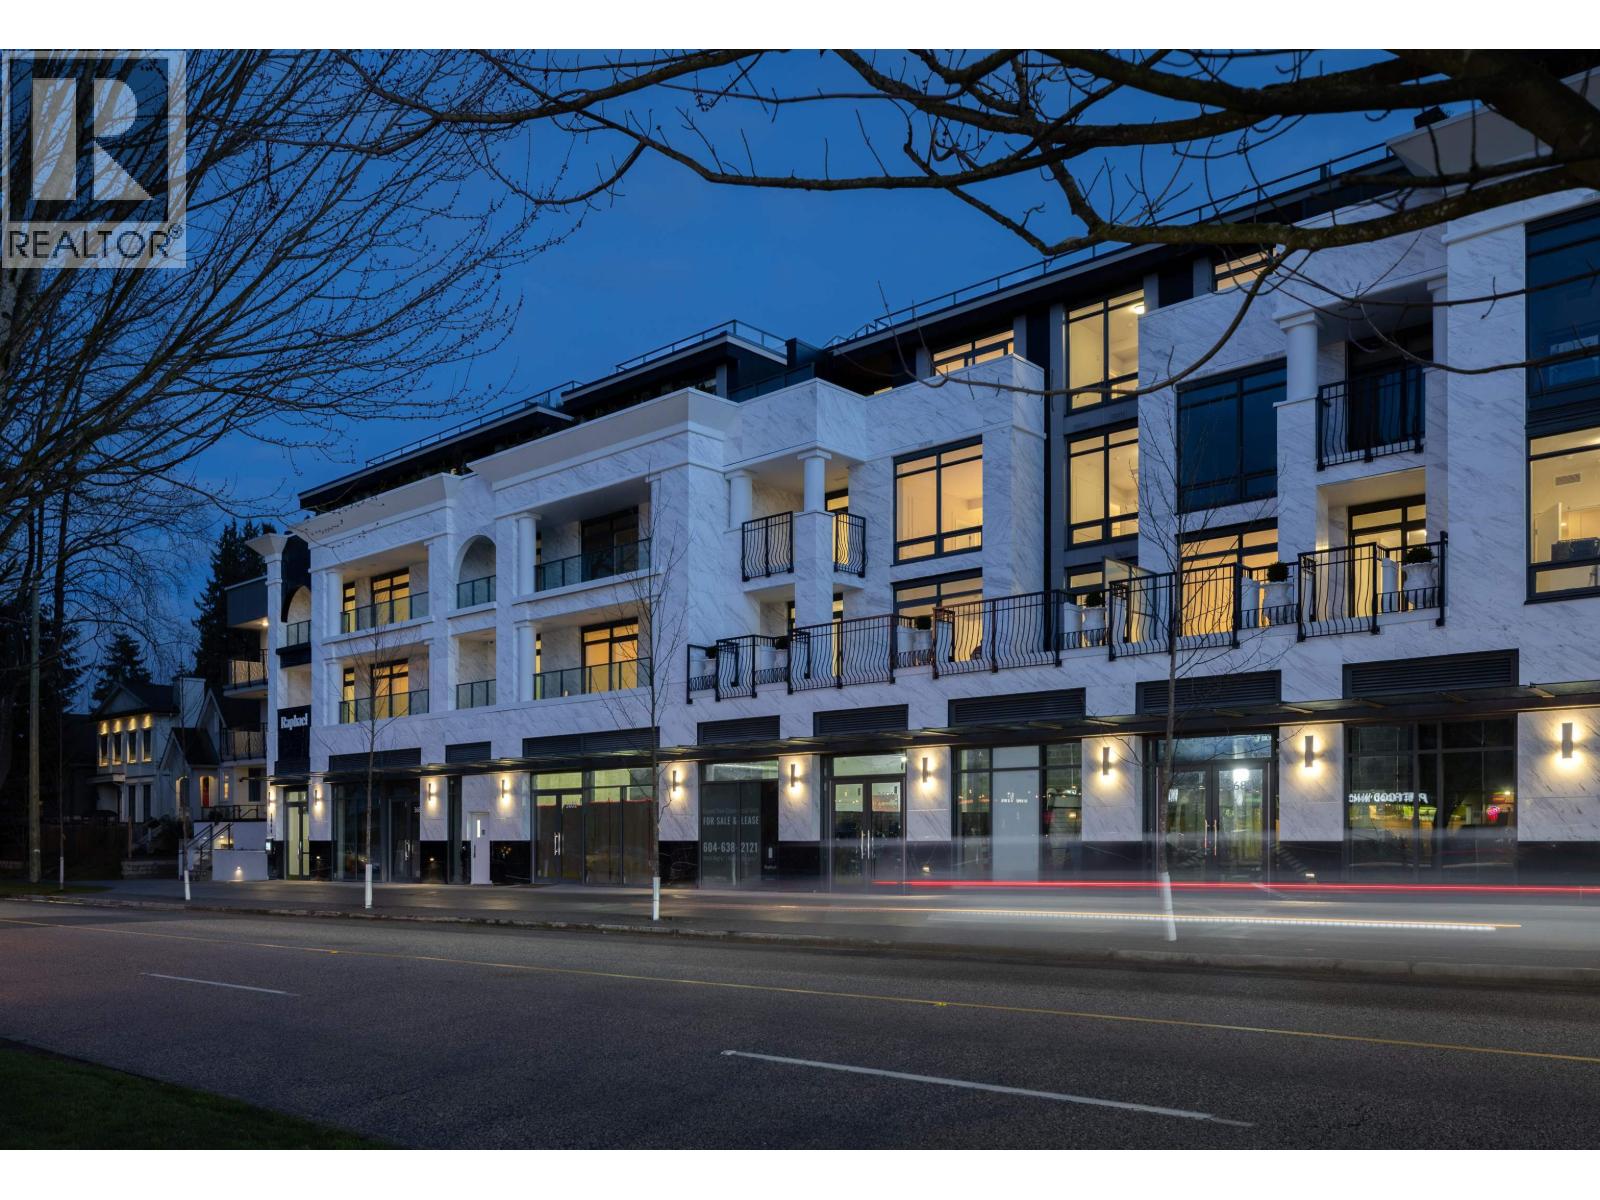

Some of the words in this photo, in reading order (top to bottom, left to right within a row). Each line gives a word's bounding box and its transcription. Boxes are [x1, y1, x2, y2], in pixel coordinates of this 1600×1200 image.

[280, 713, 308, 730] Raphael
[703, 816, 715, 825] FOR
[716, 816, 731, 825] SALE
[741, 815, 759, 825] LEASE
